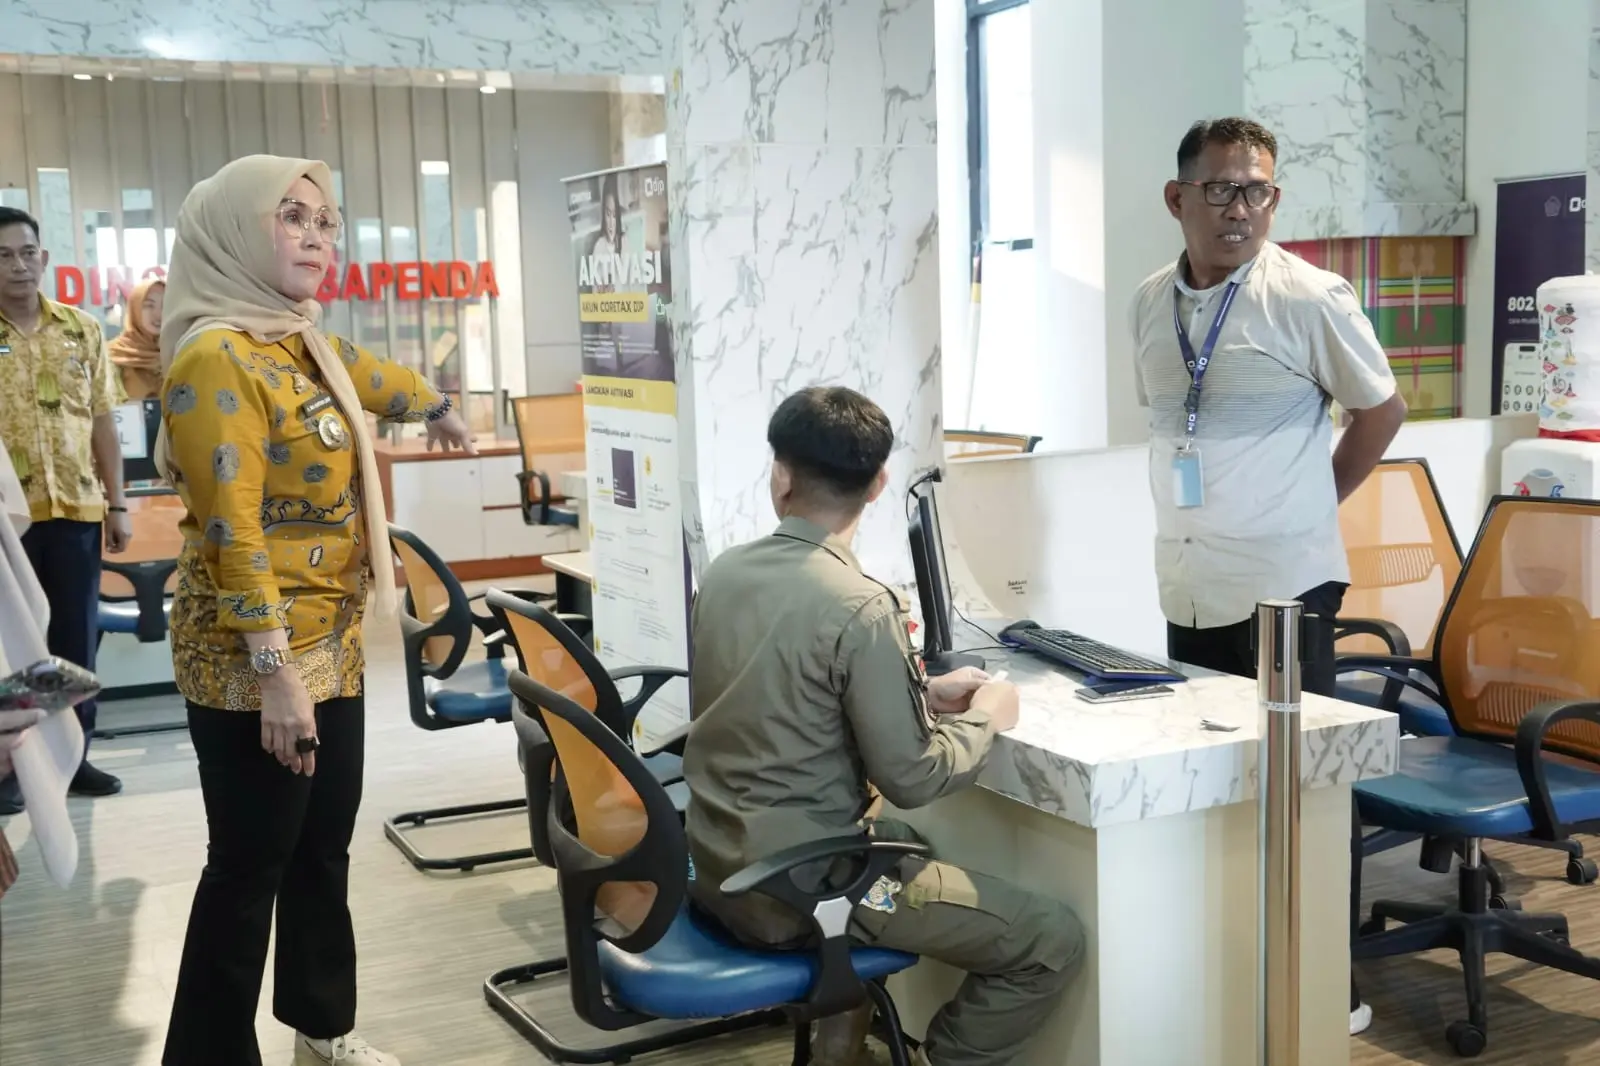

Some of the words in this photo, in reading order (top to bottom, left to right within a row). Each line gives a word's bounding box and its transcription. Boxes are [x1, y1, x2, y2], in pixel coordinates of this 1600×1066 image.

[579, 250, 662, 286] AKTIVASI
[55, 264, 167, 305] DIN
[316, 259, 500, 305] BAPENDA
[600, 300, 632, 313] CORETAX
[1507, 296, 1535, 311] 802
